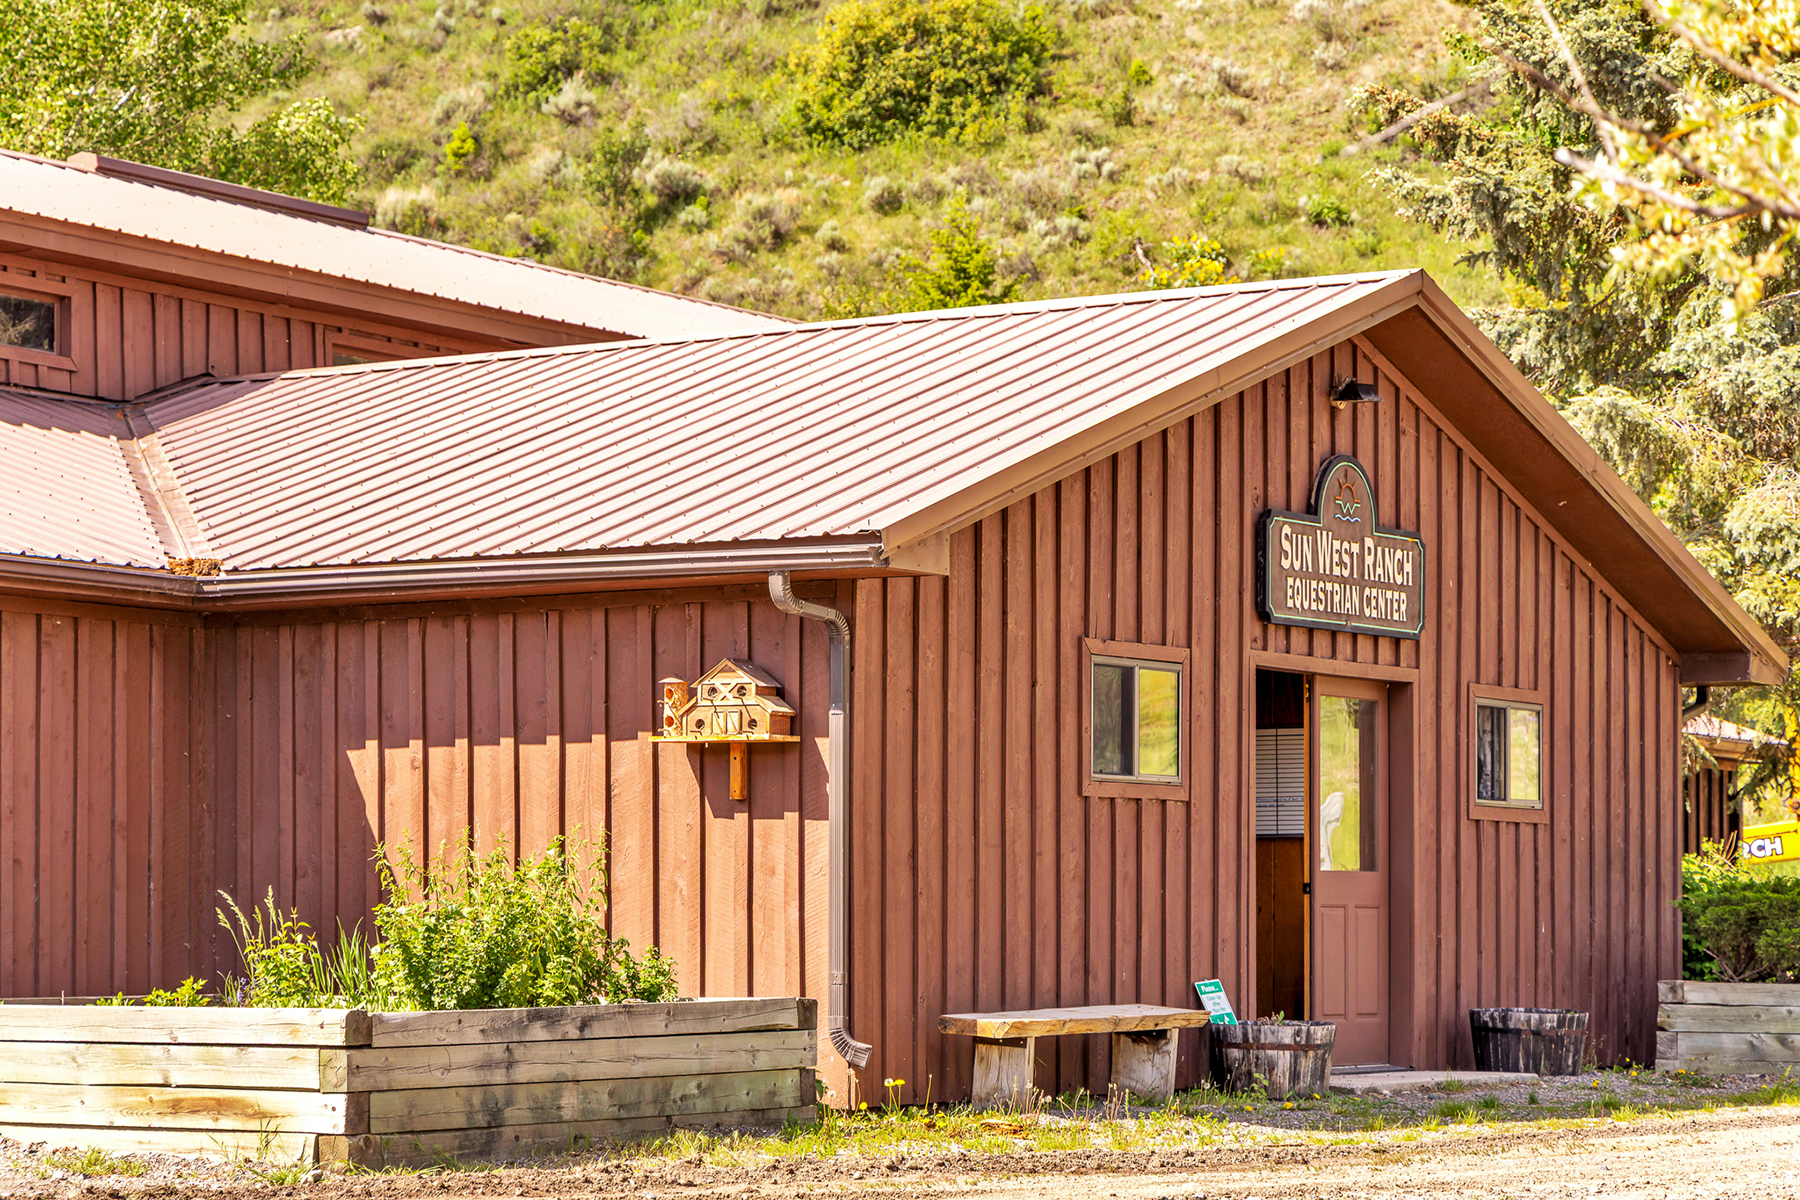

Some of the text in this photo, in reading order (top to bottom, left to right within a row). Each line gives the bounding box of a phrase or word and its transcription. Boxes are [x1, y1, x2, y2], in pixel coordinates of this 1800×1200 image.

[1280, 524, 1413, 586] SUN WEST RANCH
[1286, 576, 1407, 622] EQUESTRIAN CENTER
